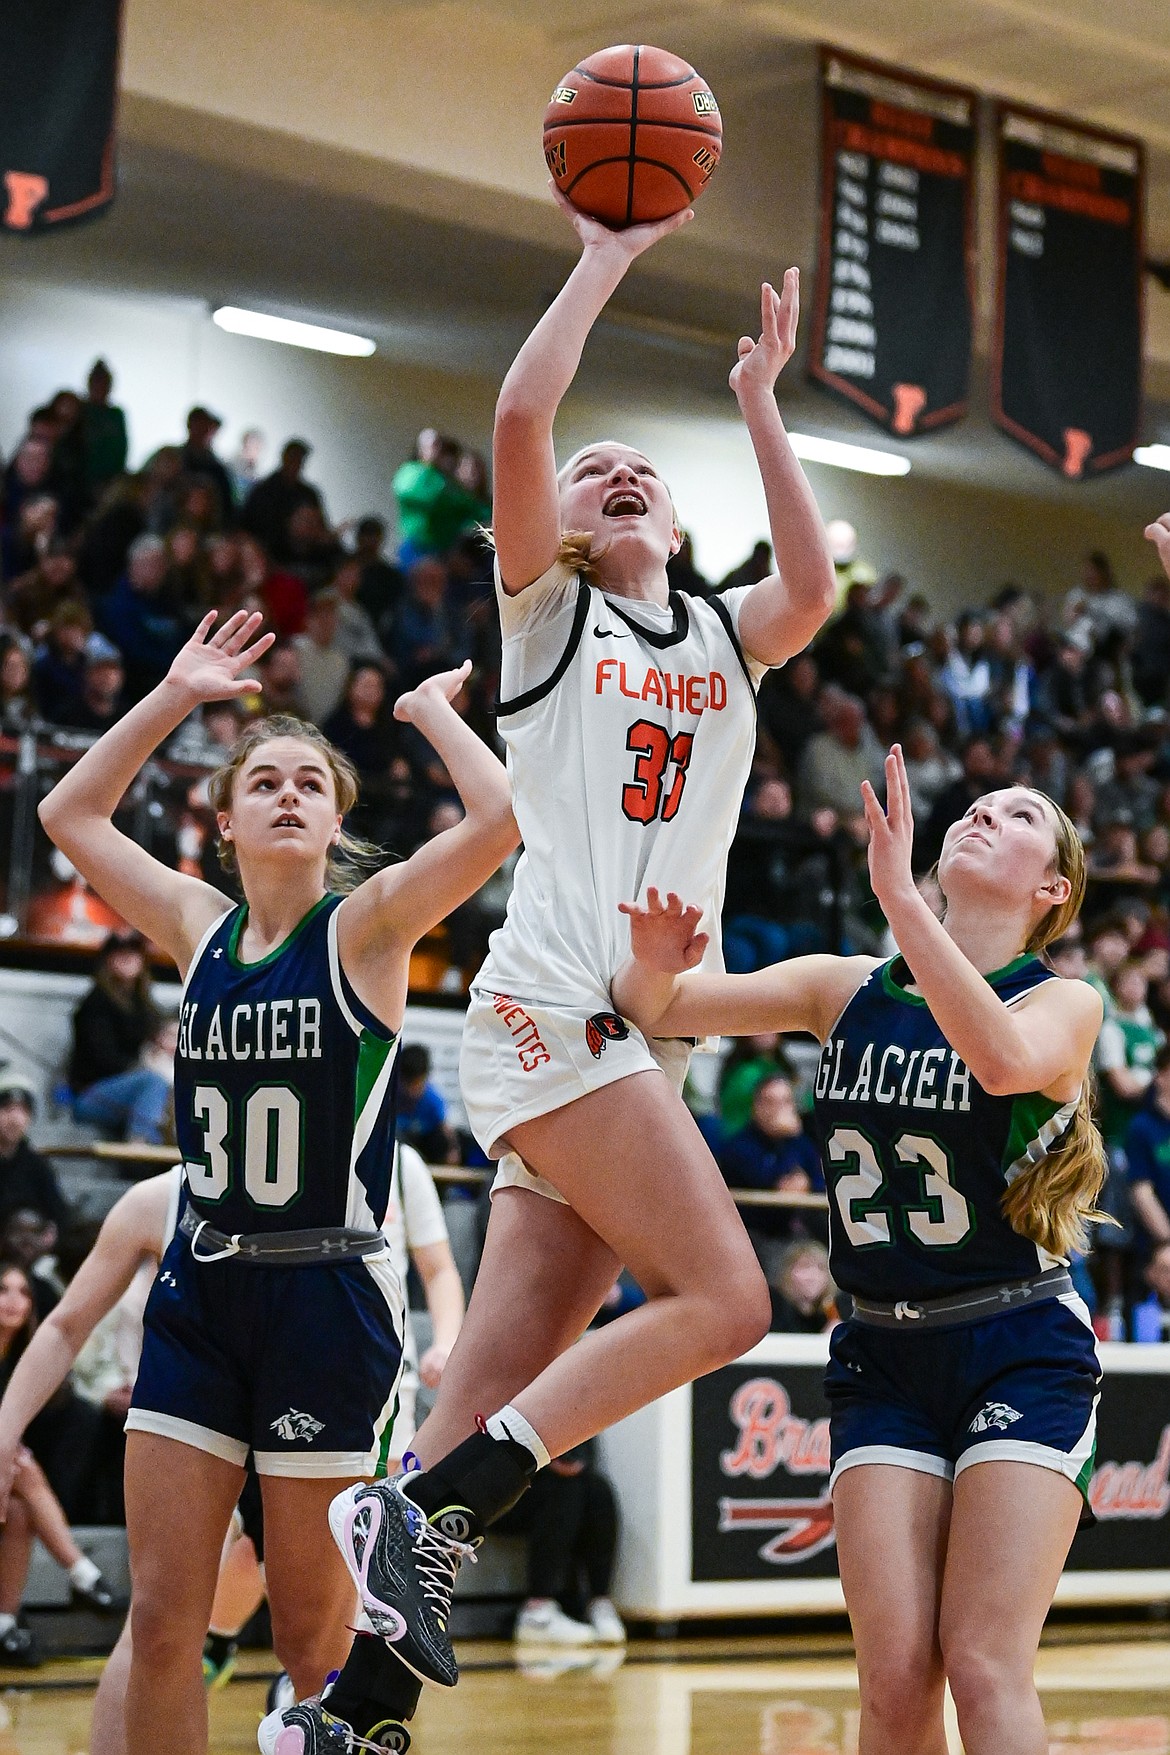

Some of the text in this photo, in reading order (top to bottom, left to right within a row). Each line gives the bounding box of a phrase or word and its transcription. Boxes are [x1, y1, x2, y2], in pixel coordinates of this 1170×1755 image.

[178, 998, 322, 1061] GLACIER
[815, 1038, 971, 1112] GLACIER
[185, 1085, 300, 1207] 30
[827, 1128, 971, 1247] 23
